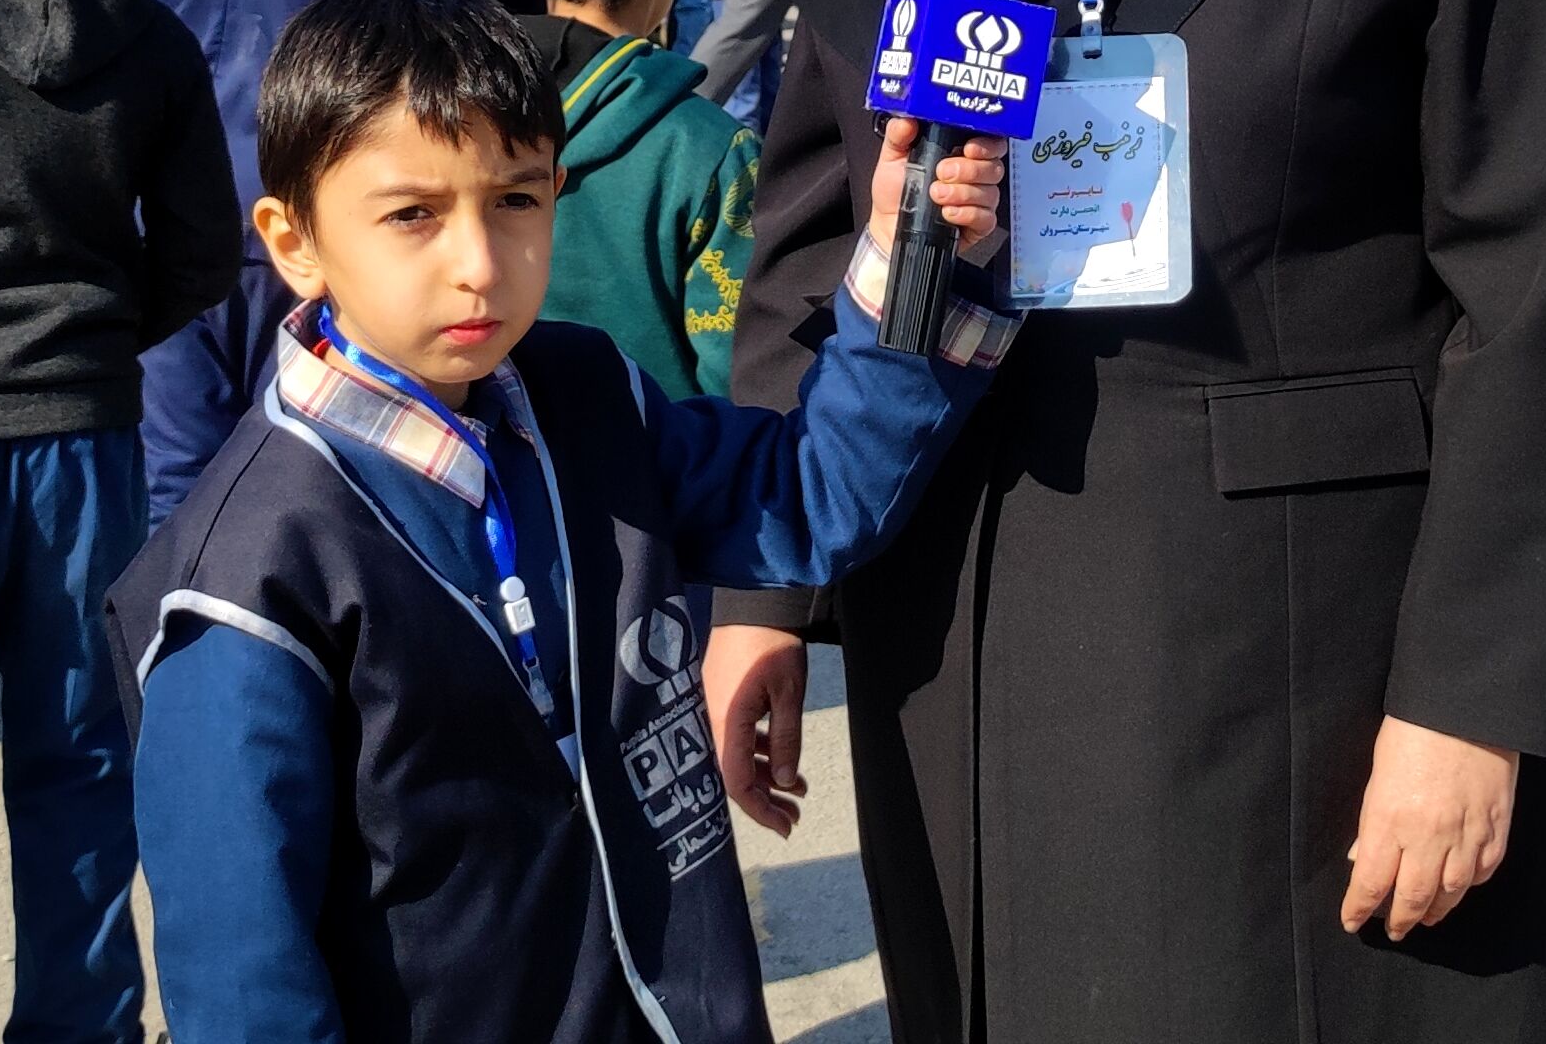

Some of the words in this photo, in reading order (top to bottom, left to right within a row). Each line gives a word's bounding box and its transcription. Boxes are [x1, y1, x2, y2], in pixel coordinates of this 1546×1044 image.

[934, 60, 1024, 98] PANA
[946, 90, 961, 107] پانا
[960, 95, 1004, 115] خبرگزاری
[1032, 120, 1094, 168] فیروزی
[1093, 121, 1145, 161] زینب
